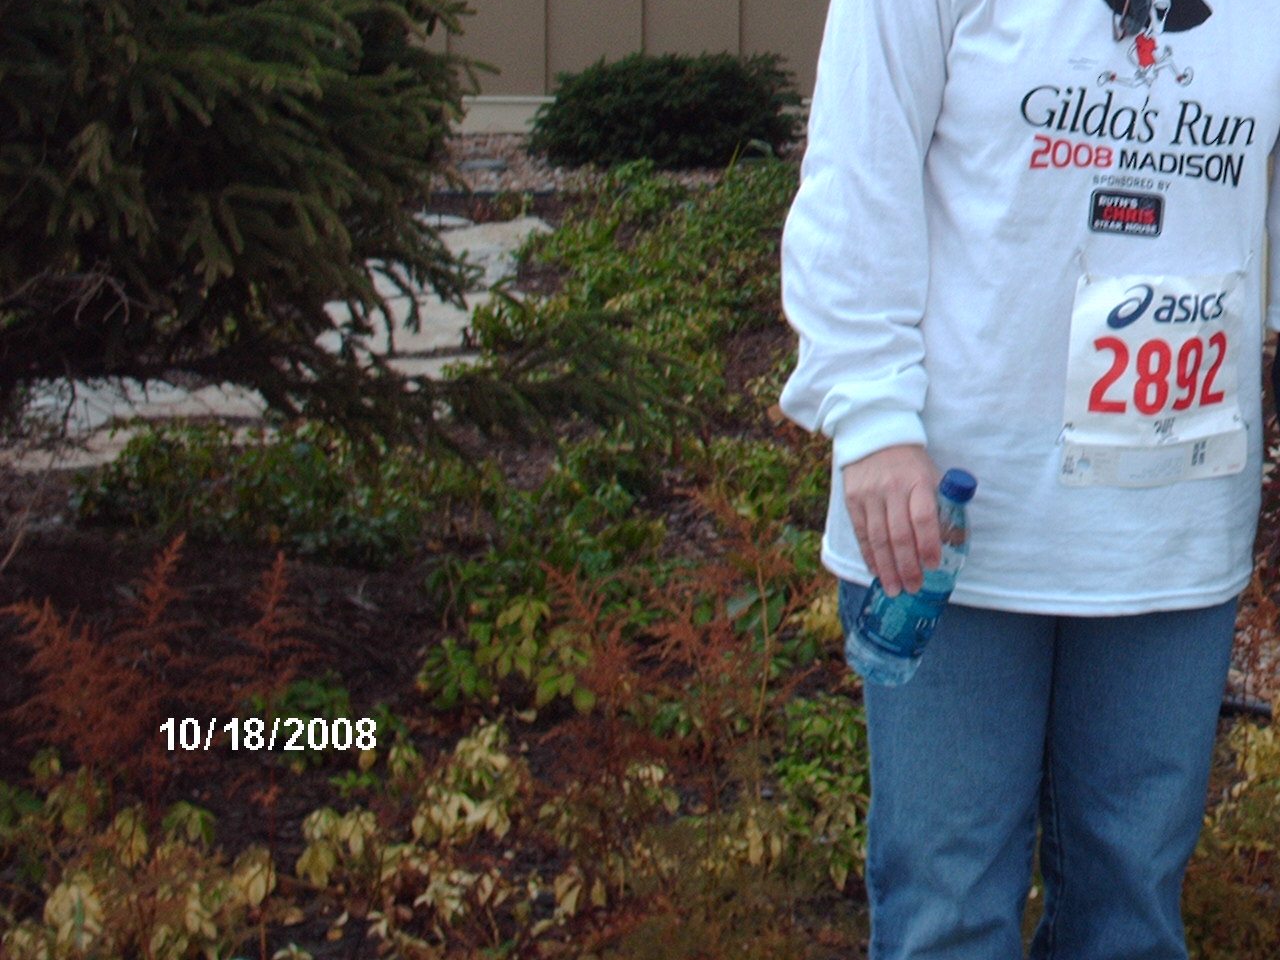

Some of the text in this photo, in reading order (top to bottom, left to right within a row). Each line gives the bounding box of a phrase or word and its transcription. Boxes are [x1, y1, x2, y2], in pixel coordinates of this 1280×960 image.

[1020, 84, 1256, 148] Gilda's Run
[1029, 134, 1246, 189] 2008 MADISON
[1092, 174, 1172, 192] SPONSORED BY
[1103, 204, 1157, 225] CHRIS
[1086, 329, 1229, 417] 2892
